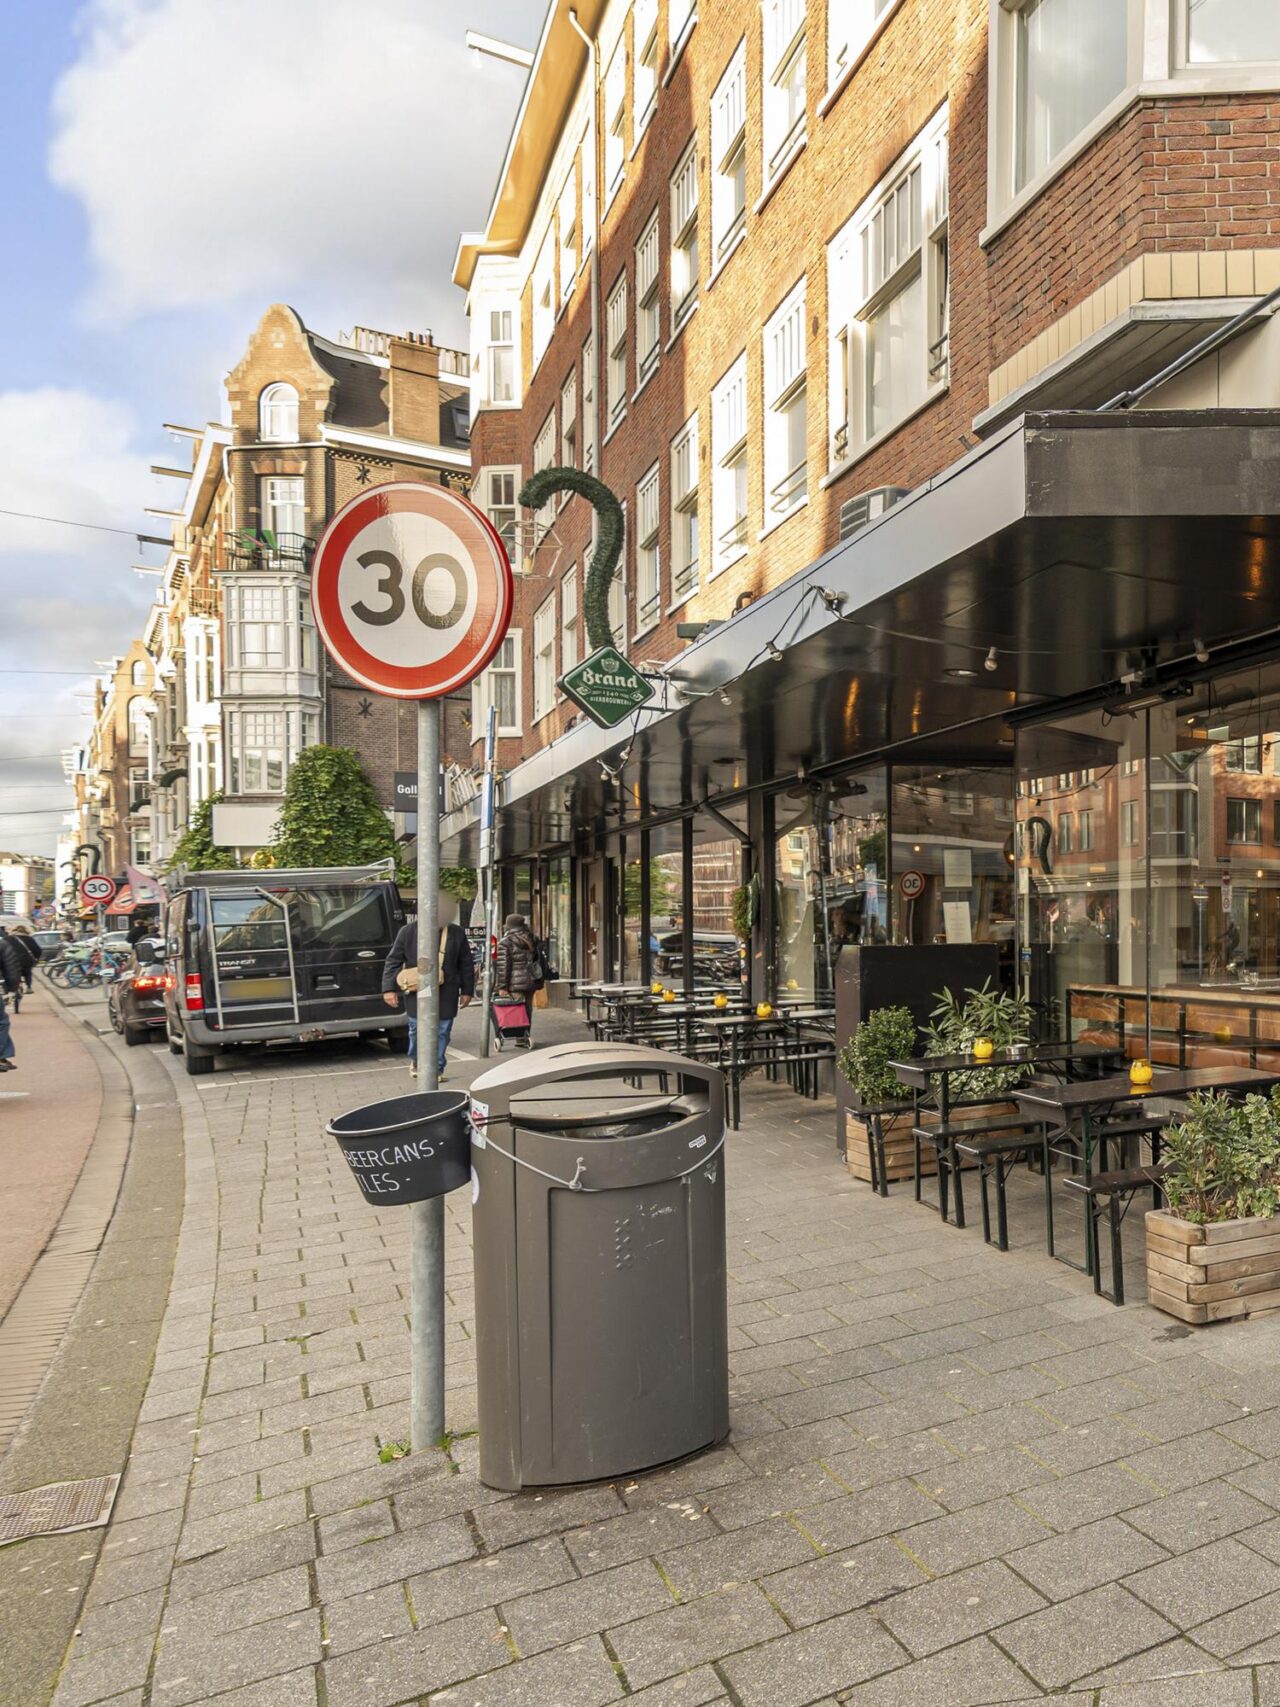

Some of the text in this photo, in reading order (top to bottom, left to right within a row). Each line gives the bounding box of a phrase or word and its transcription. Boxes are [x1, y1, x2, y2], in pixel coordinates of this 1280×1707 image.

[350, 549, 468, 630] 30
[582, 667, 638, 688] Brand
[87, 883, 109, 893] 30
[218, 958, 257, 967] TRANSIT
